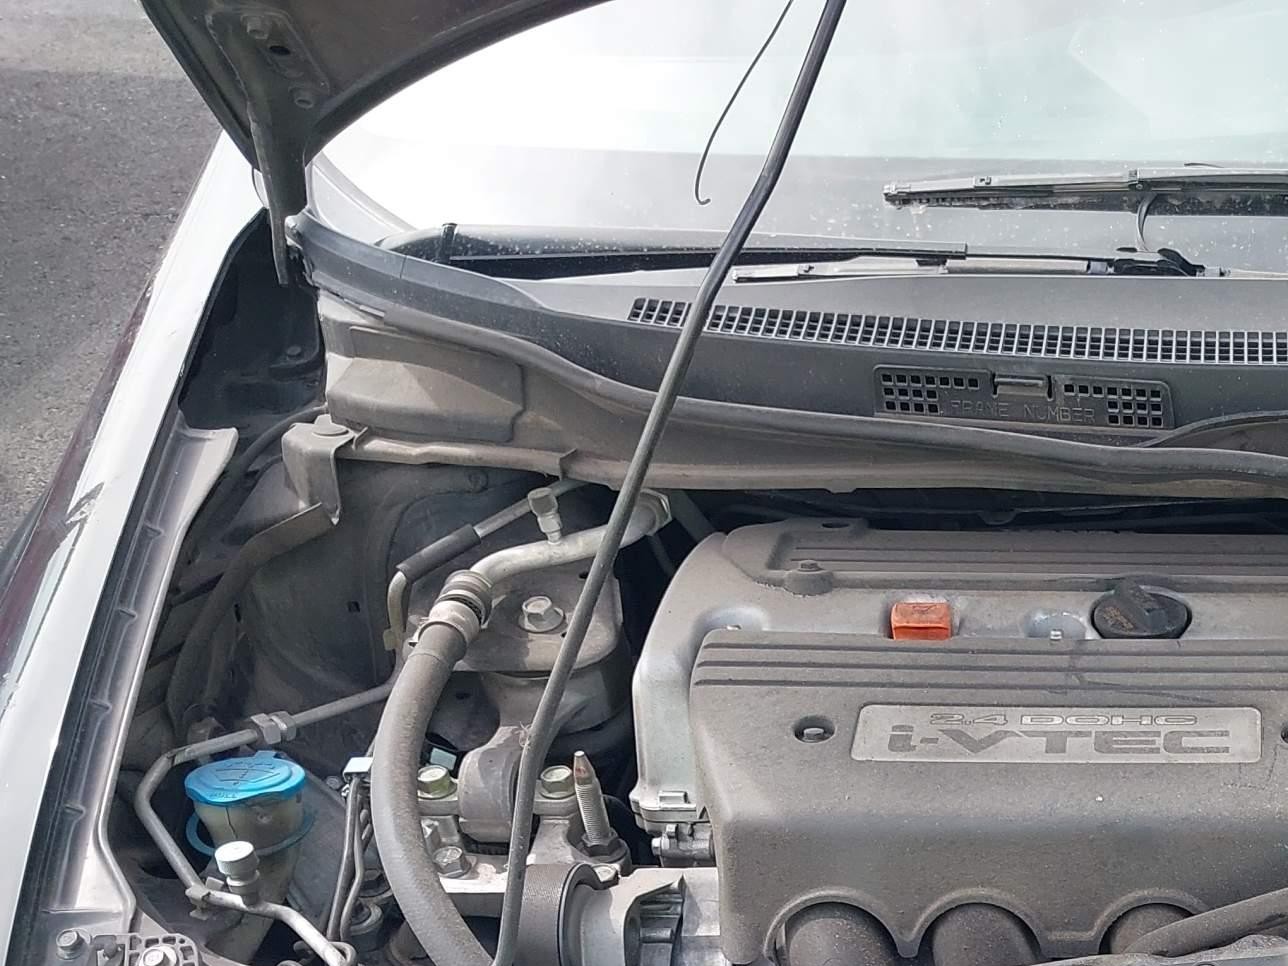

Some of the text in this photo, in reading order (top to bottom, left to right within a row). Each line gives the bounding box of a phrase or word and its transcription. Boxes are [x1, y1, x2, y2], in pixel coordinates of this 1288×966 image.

[950, 400, 1096, 424] FRAME NUMBER
[929, 713, 1199, 727] 2.4 DOHC
[887, 724, 1231, 755] i-VTEC
